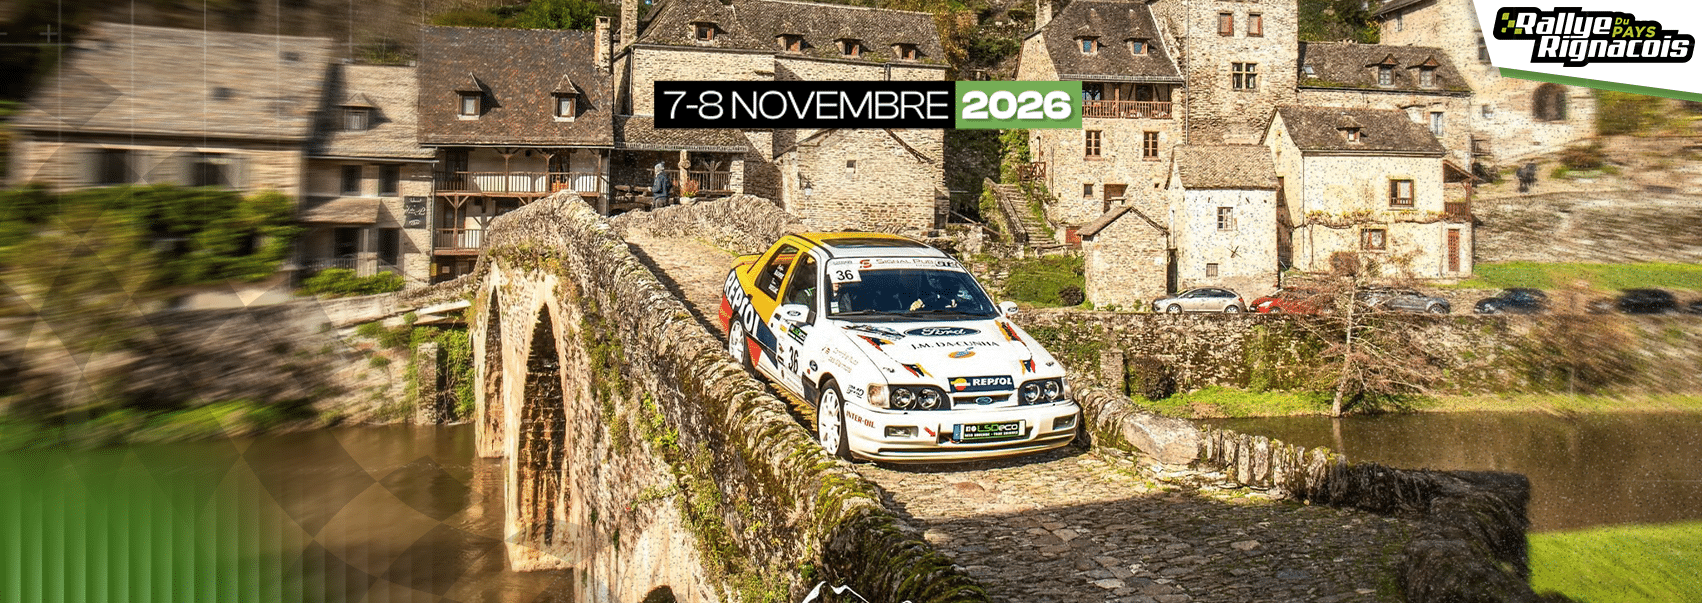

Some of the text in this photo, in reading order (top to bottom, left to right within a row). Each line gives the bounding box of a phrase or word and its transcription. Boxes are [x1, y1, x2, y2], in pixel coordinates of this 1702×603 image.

[835, 269, 854, 281] 36
[724, 269, 760, 338] REPSOL
[920, 325, 966, 336] Ford
[788, 345, 798, 375] 36
[972, 377, 1012, 387] REPSOL
